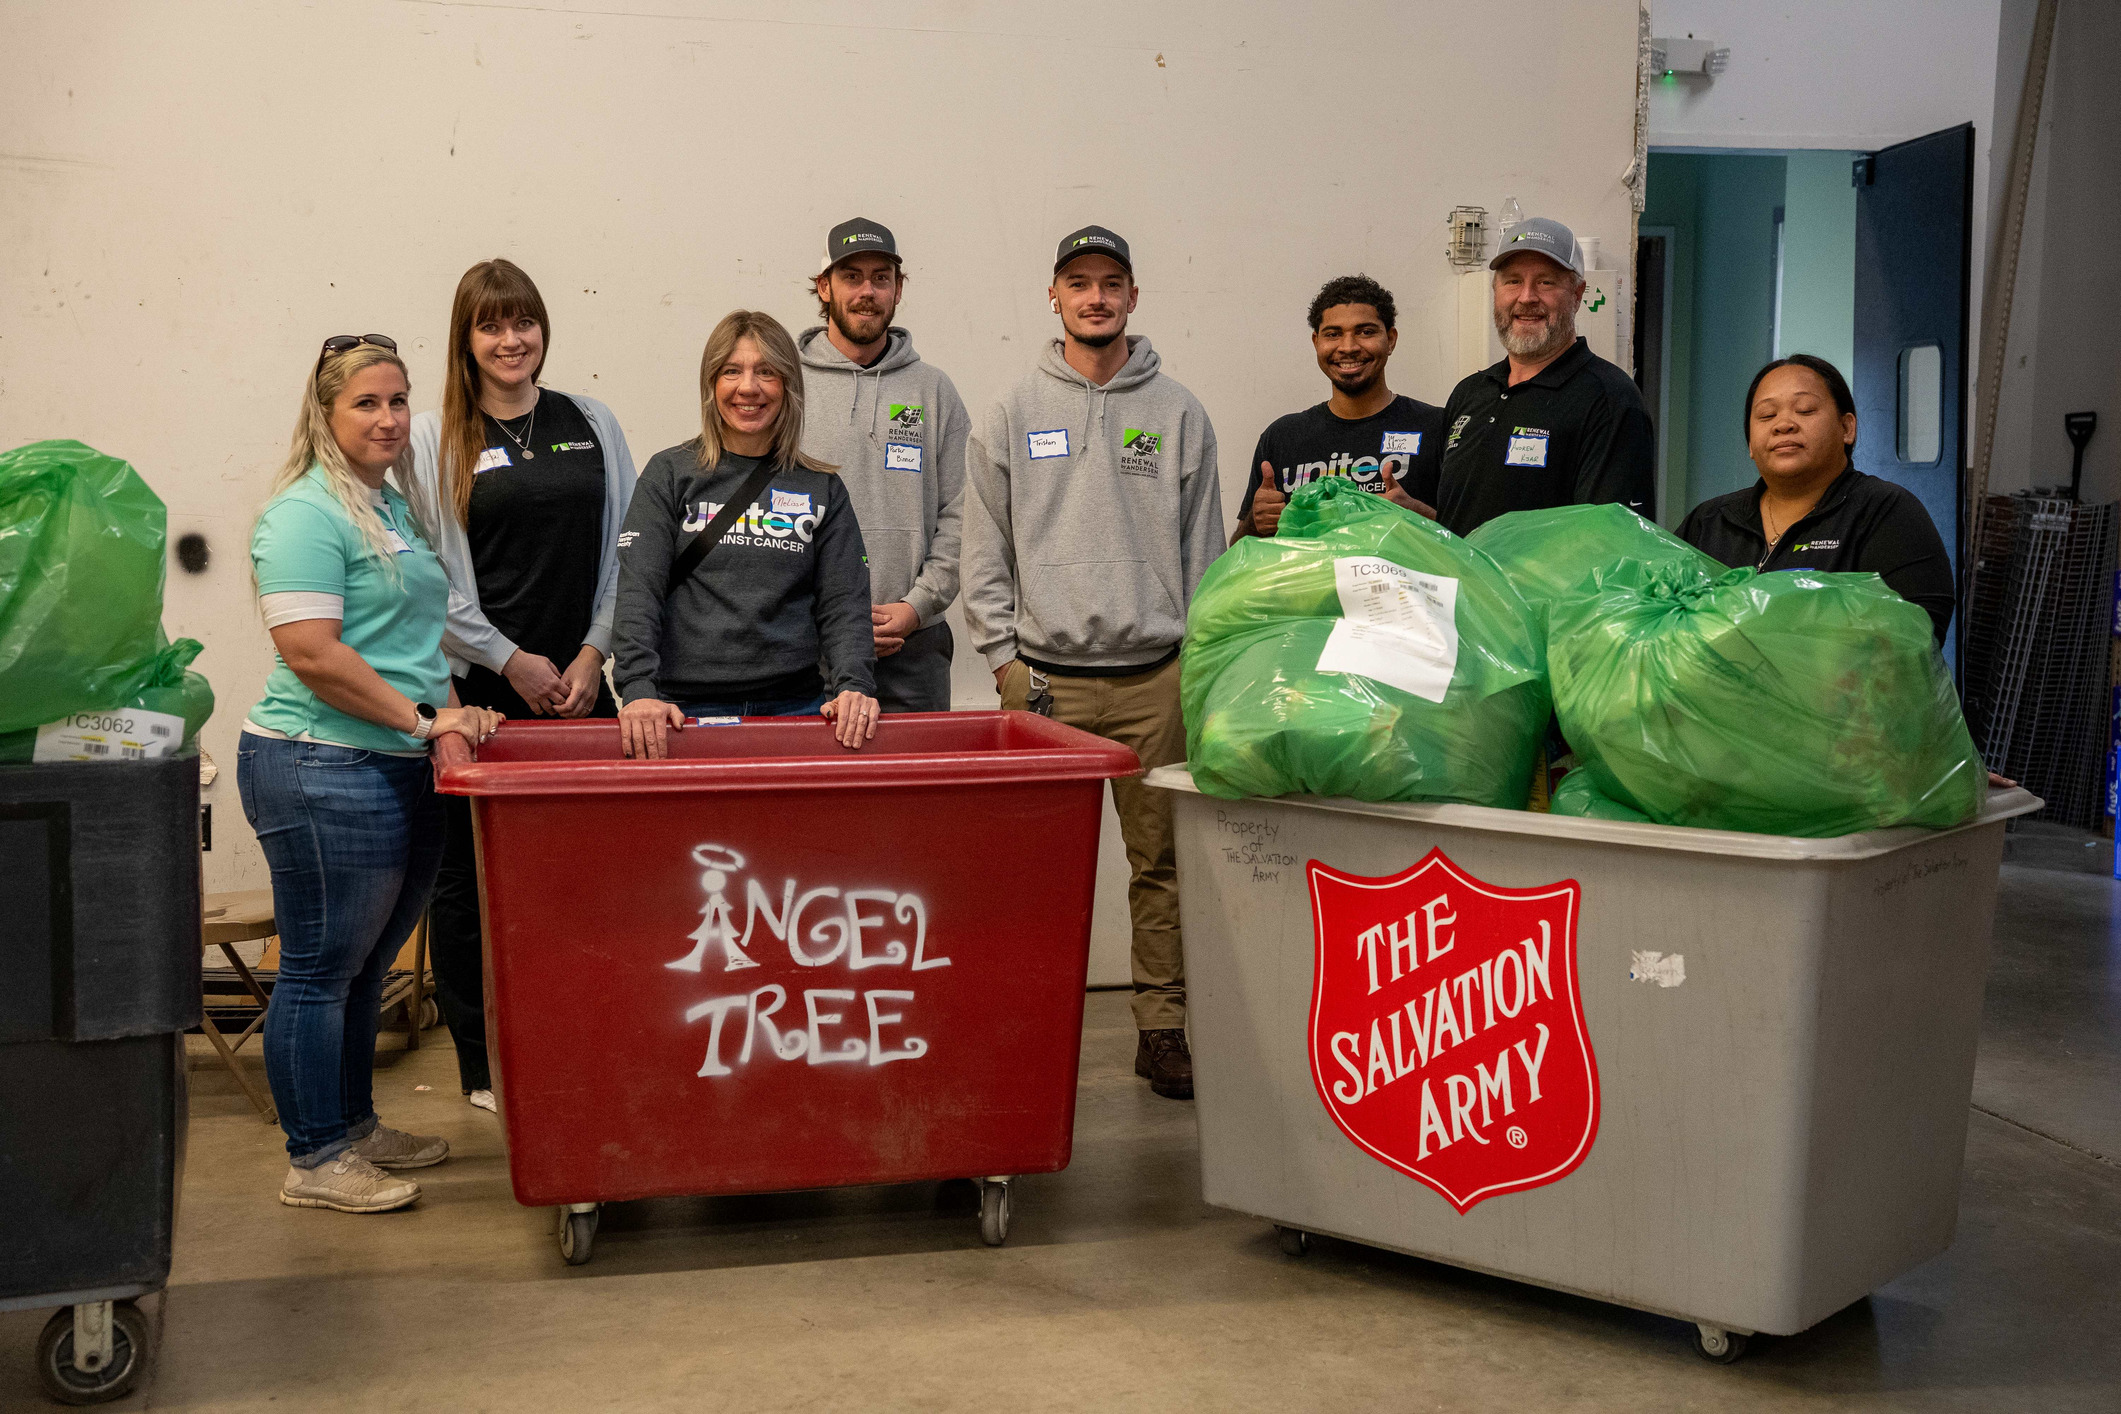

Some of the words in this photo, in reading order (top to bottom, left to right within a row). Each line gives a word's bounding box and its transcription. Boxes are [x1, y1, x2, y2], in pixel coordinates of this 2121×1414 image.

[889, 428, 923, 439] RENEWAL
[1121, 456, 1158, 470] RENEWAL
[1126, 465, 1158, 475] ANDERSEN
[1283, 452, 1410, 493] united
[753, 537, 804, 553] CANCER
[1217, 810, 1279, 843] Property
[1222, 848, 1240, 863] THE
[1242, 846, 1298, 865] SALVATION
[1250, 836, 1263, 852] of
[1252, 866, 1279, 883] ARMY
[664, 868, 951, 972] ANGEL
[1356, 893, 1457, 996] THE
[1330, 919, 1553, 1105] SALVATION
[685, 984, 928, 1078] TREE
[1416, 1022, 1550, 1162] ARMY
